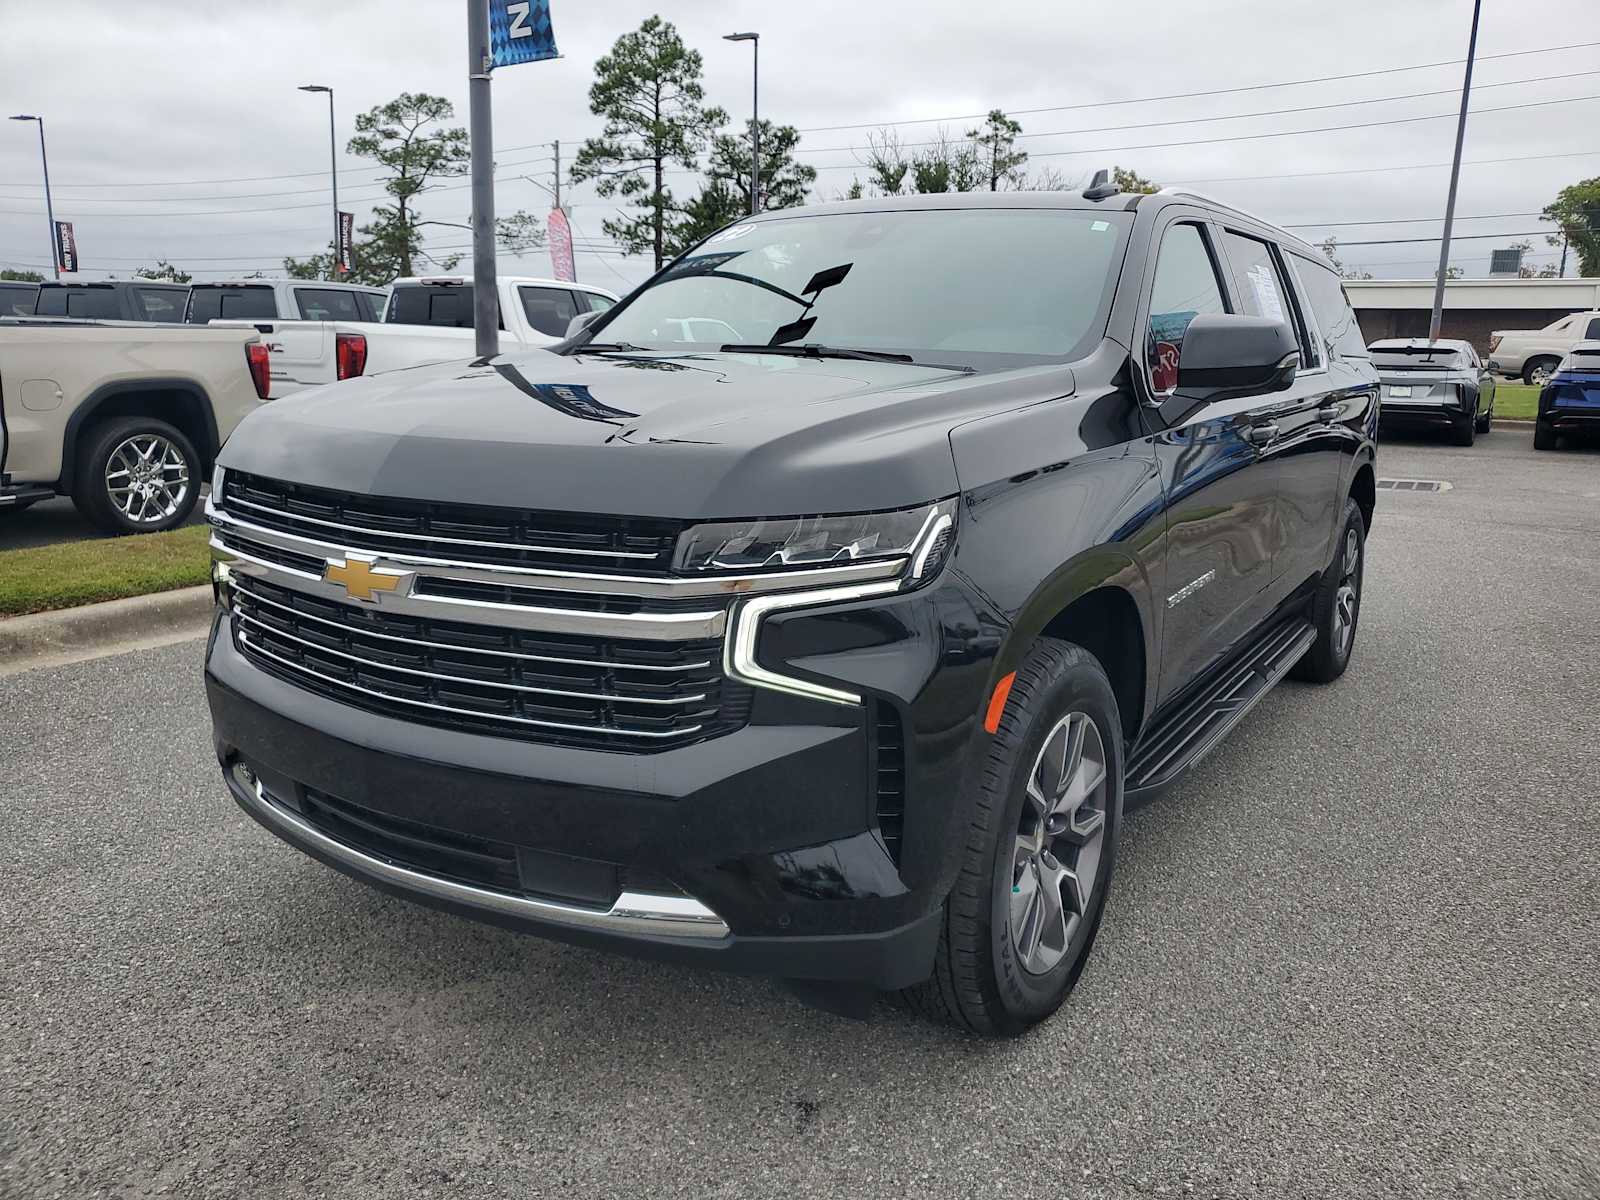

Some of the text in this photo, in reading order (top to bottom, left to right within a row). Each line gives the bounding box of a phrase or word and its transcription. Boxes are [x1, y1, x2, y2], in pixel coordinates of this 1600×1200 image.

[61, 224, 72, 270] NEW TRUCKS
[342, 215, 351, 270] NEW TRUCKS
